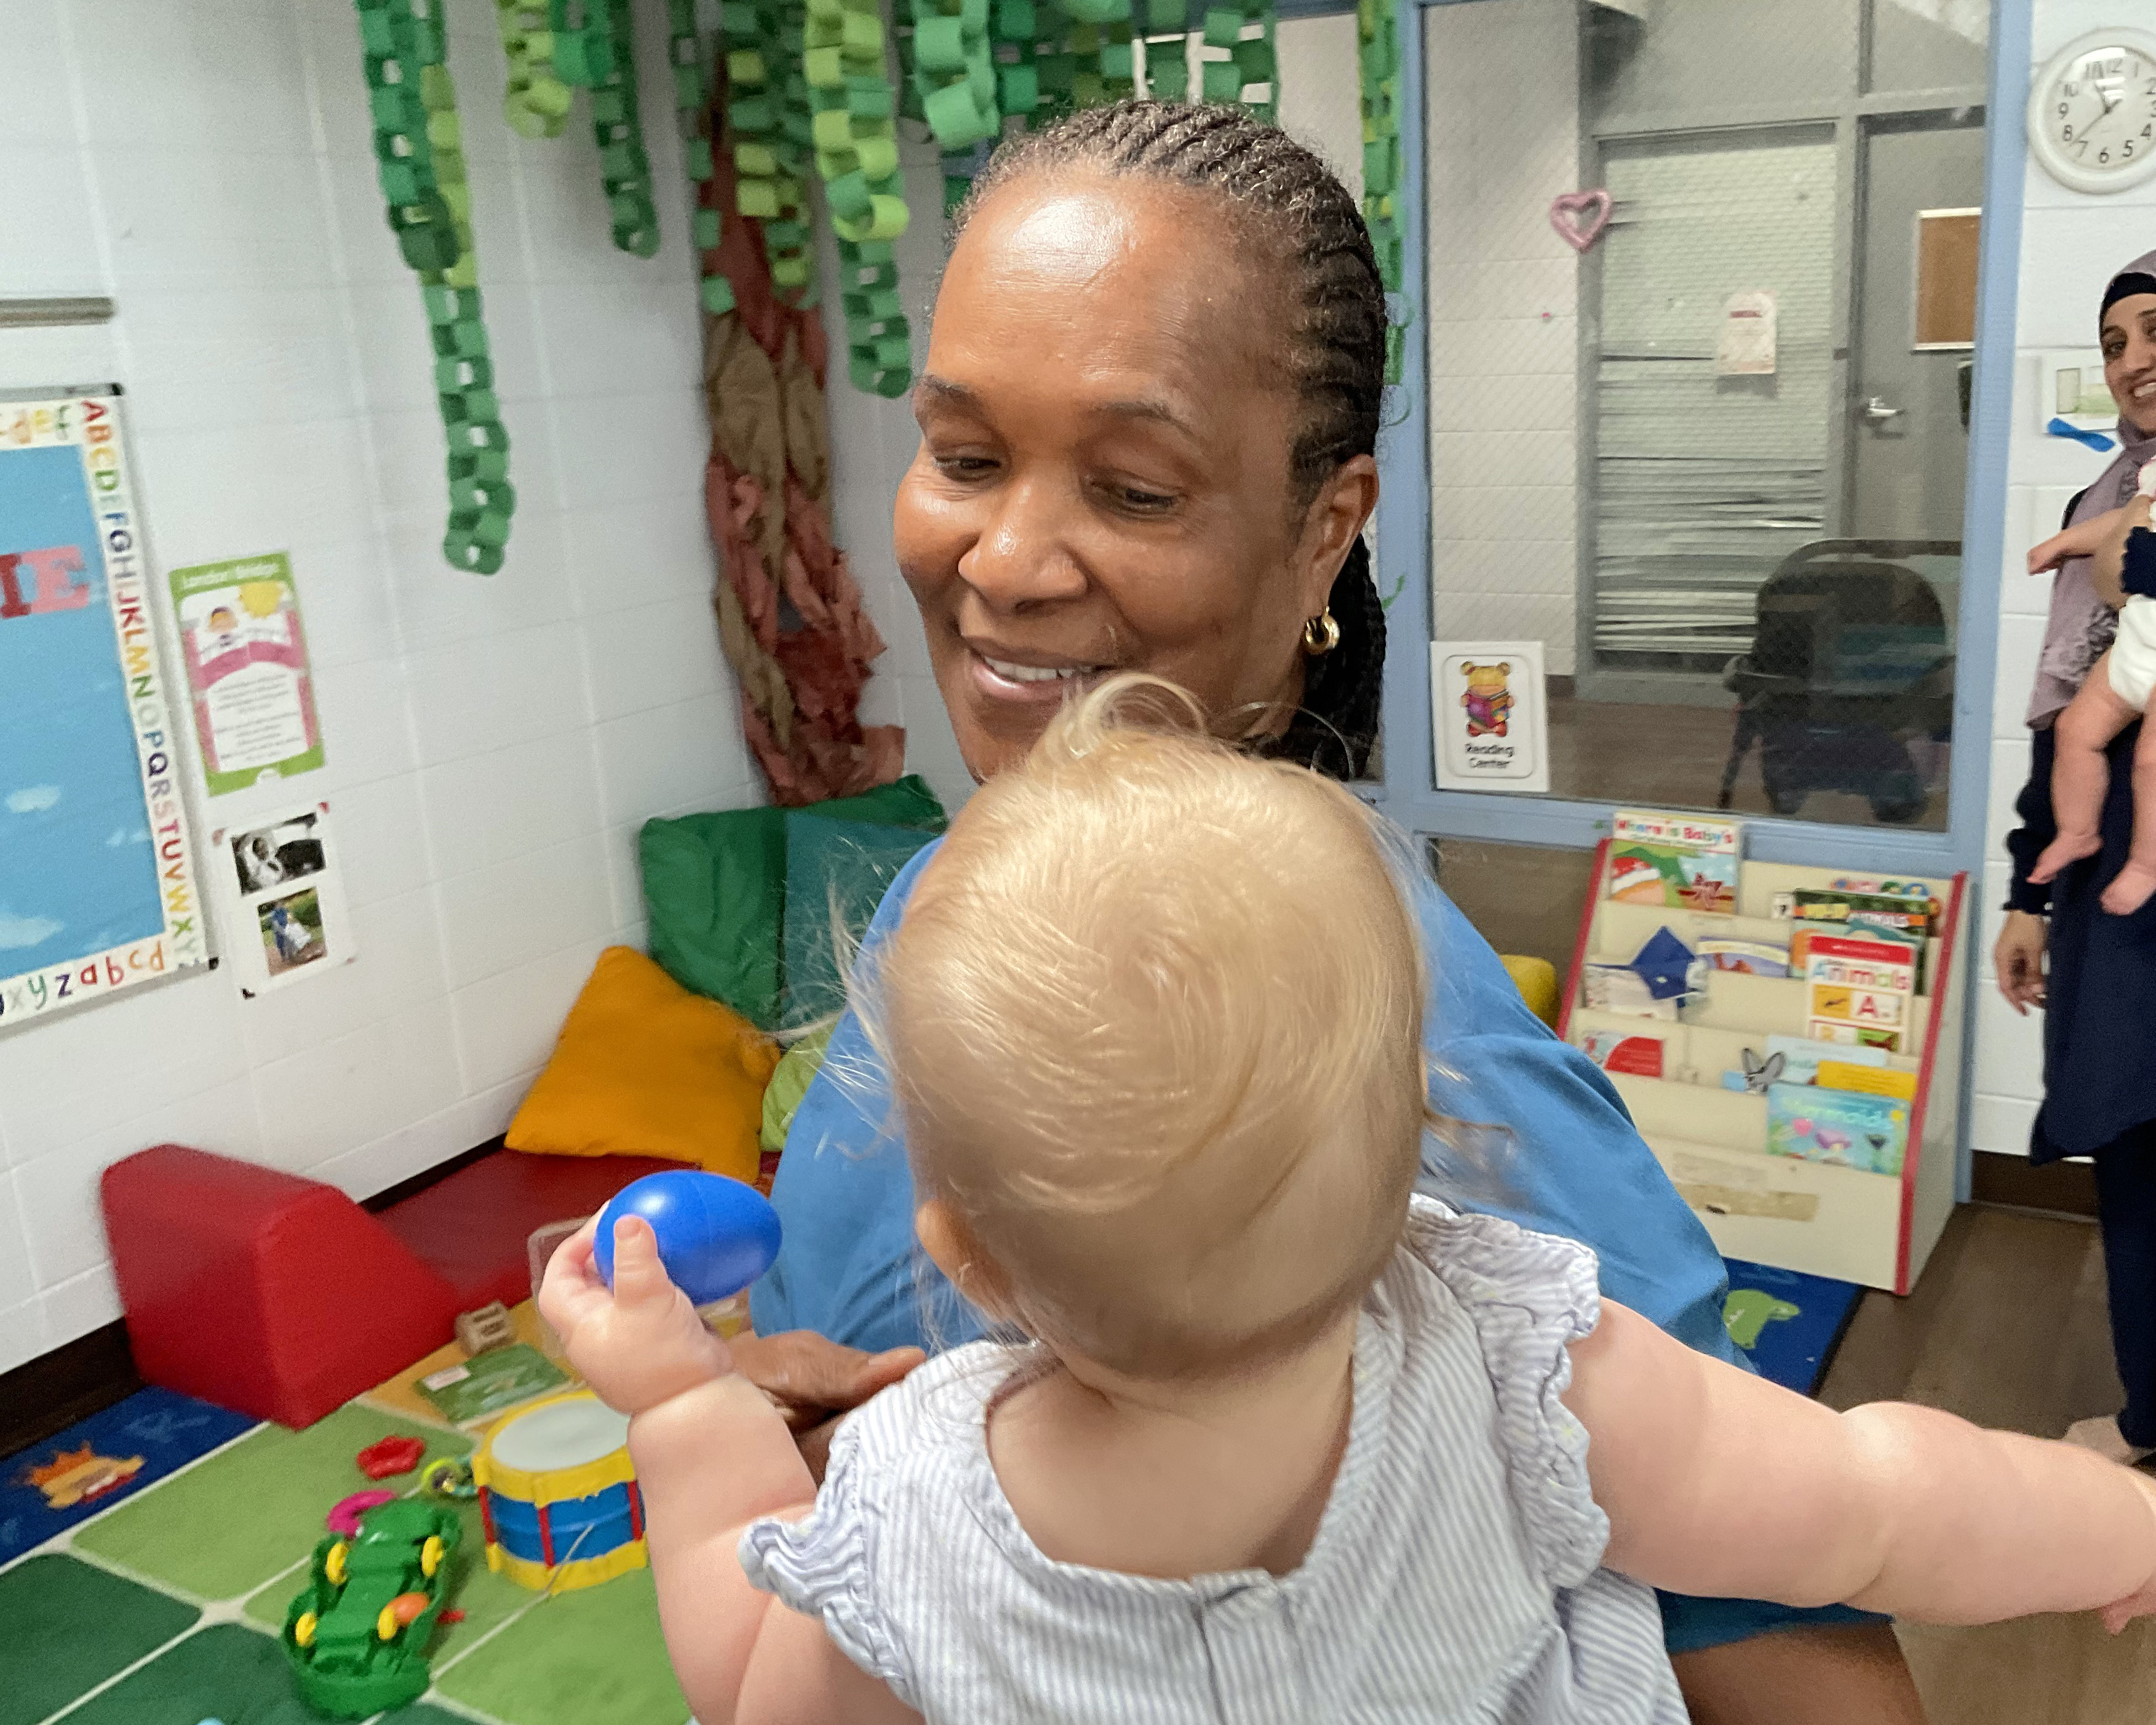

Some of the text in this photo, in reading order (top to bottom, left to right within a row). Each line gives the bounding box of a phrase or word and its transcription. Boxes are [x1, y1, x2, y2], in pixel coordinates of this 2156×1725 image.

[2058, 102, 2069, 120] 9
[2063, 124, 2073, 141] 8
[2140, 123, 2152, 141] 4
[2074, 140, 2089, 157] 7
[2098, 146, 2110, 164] 6
[2122, 139, 2134, 157] 5
[1813, 960, 1911, 990] Animals
[1856, 995, 1880, 1019] A
